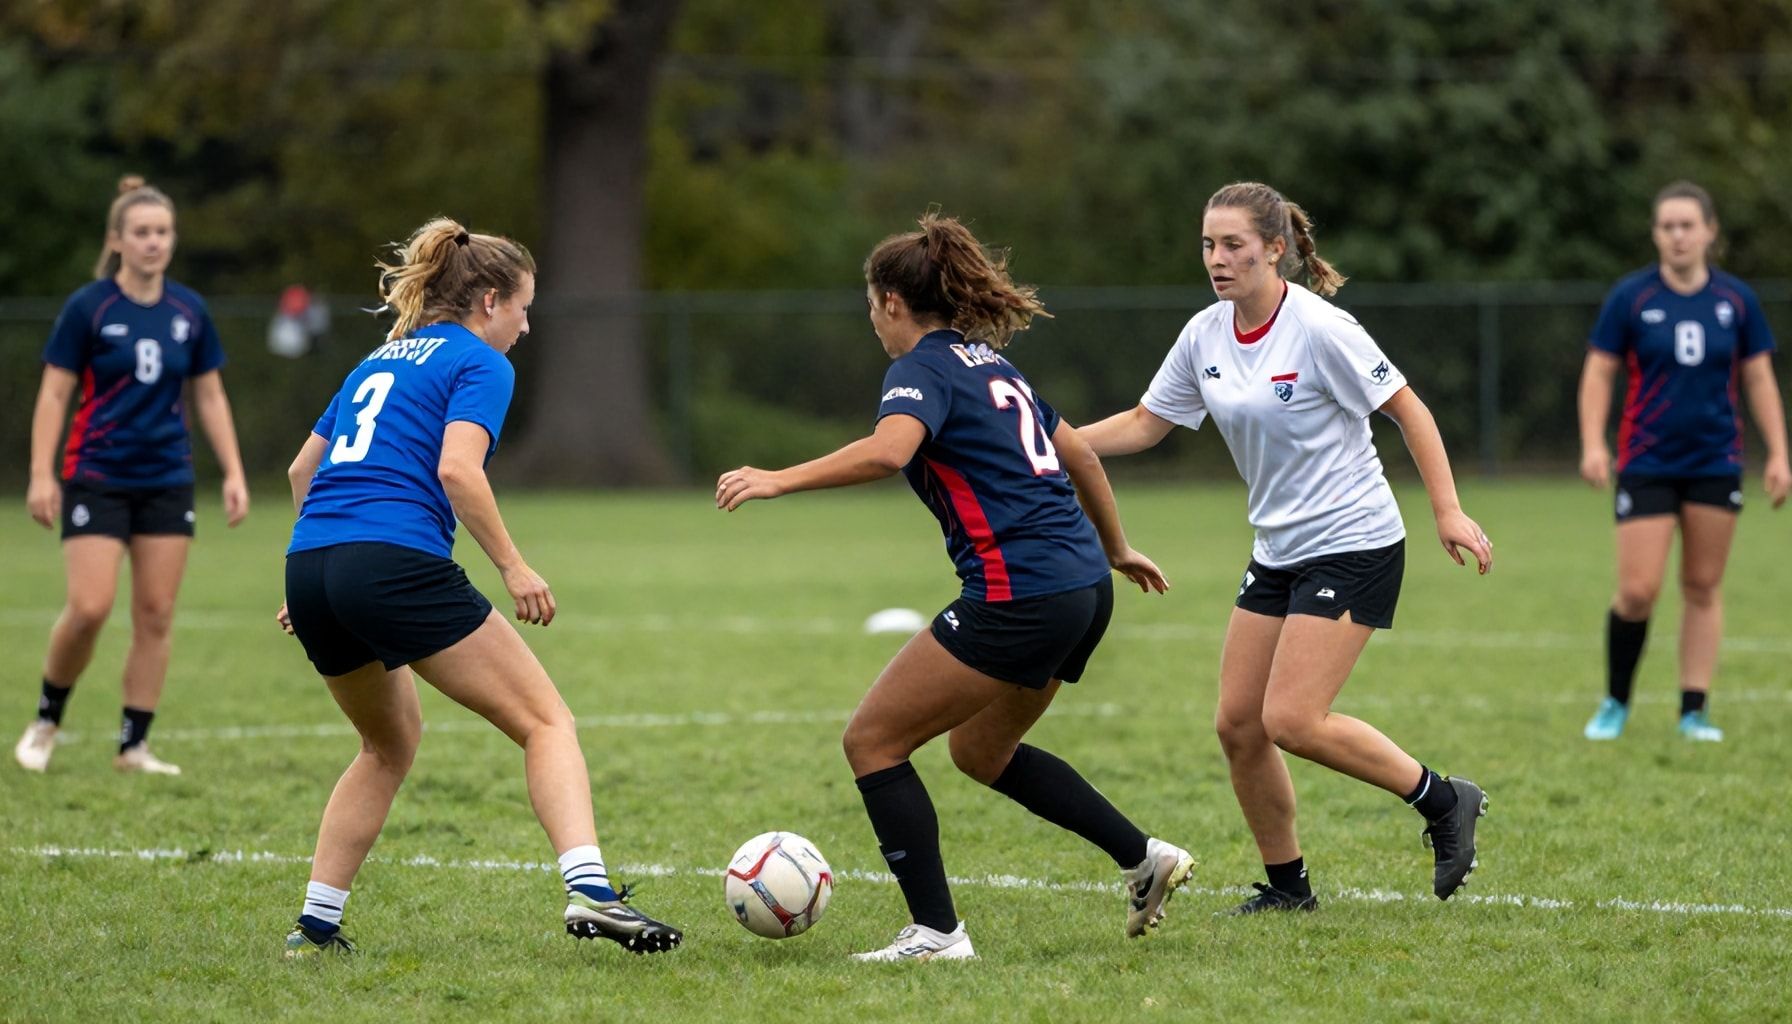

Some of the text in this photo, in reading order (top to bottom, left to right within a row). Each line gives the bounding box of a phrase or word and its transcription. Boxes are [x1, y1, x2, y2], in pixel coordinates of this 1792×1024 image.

[135, 338, 162, 385] 8
[1674, 320, 1706, 366] 8
[330, 372, 395, 464] 3
